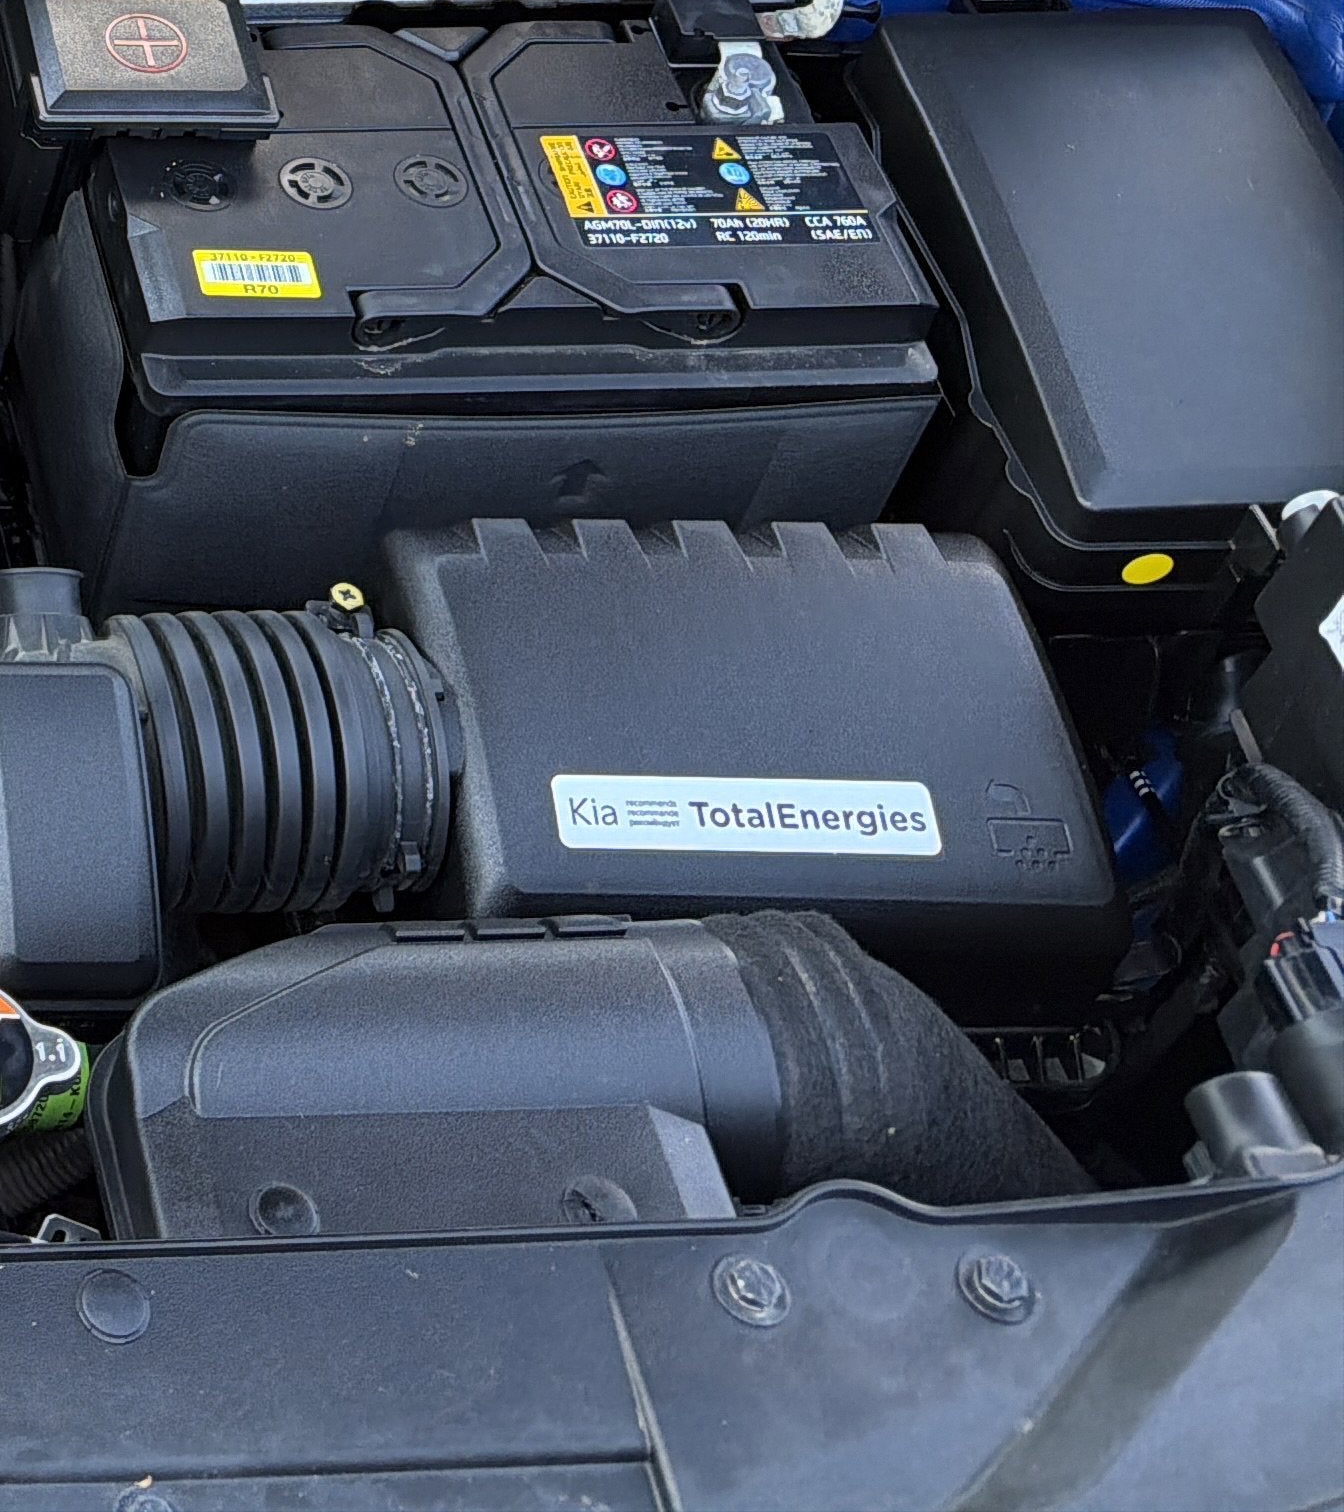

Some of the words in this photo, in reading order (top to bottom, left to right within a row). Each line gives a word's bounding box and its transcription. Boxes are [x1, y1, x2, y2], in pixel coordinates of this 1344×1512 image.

[745, 216, 790, 228] (20HR)
[804, 217, 833, 227] CCA
[835, 216, 867, 227] 760A
[587, 233, 669, 245] 37110-F2720
[715, 231, 736, 242] RC
[737, 230, 783, 241] 120min
[243, 284, 279, 295] R70
[568, 796, 619, 827] Kia
[689, 799, 927, 837] TotalEnergies
